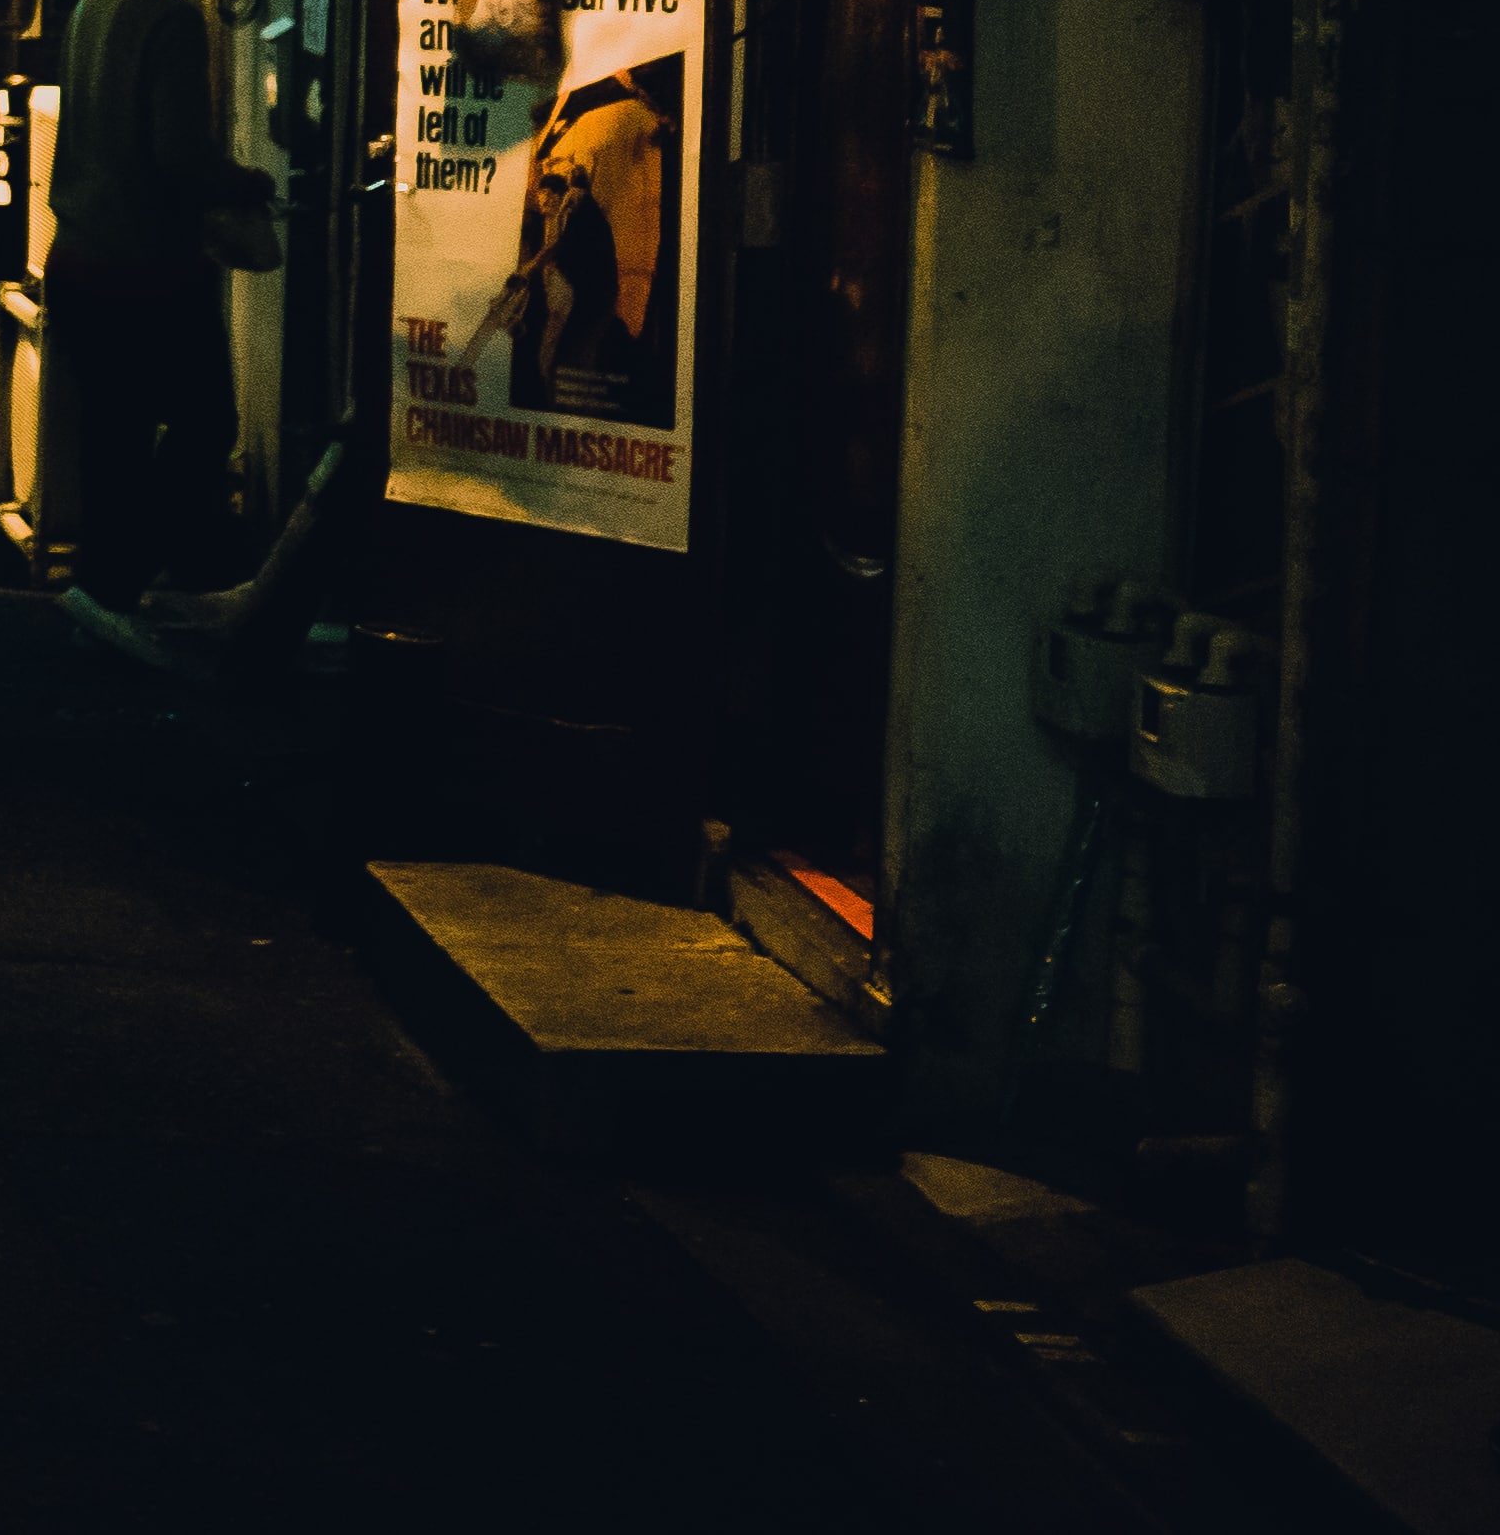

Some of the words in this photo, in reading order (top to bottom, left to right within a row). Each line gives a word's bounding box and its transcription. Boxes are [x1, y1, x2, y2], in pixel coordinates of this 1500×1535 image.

[417, 106, 457, 146] left
[463, 108, 489, 148] of
[415, 151, 497, 195] them?
[401, 317, 448, 358] THE
[406, 360, 478, 406] TEXAS
[406, 406, 531, 460] CHAINSAW
[535, 423, 677, 483] MASSACRE
